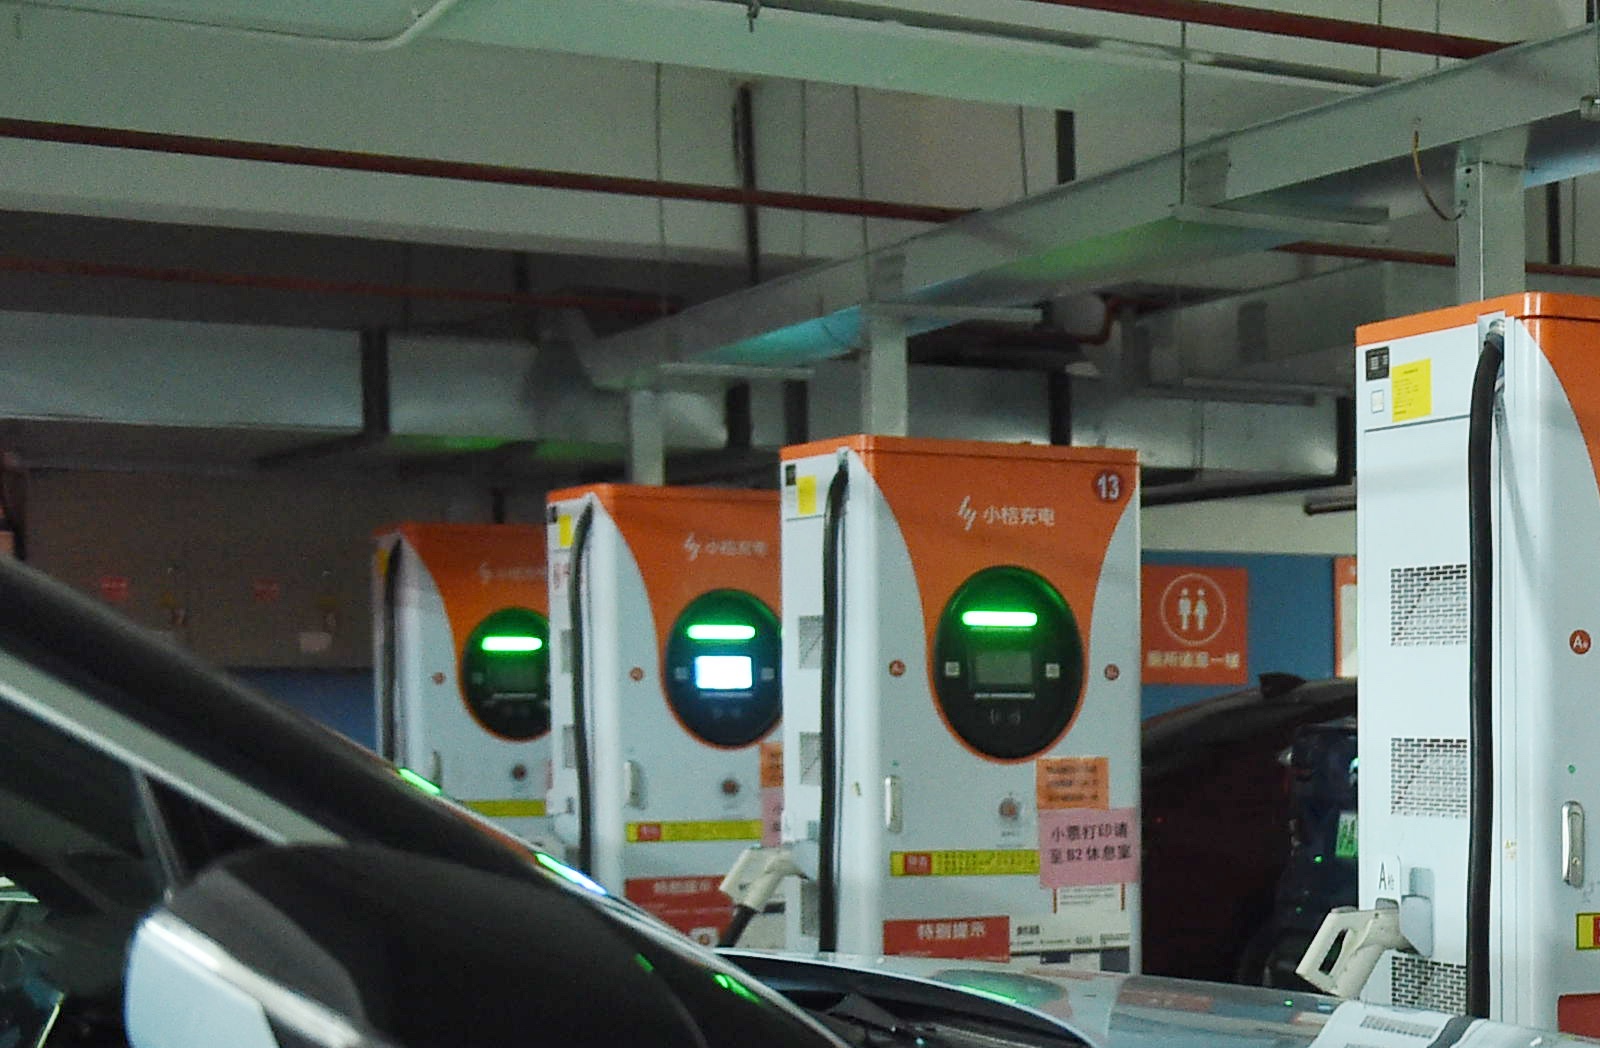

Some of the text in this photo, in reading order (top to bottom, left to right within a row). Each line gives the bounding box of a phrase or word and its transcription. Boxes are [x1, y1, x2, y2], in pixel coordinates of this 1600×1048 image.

[1098, 474, 1120, 501] 13
[983, 505, 1056, 527] 小桔充电
[1051, 822, 1128, 843] 小票打印请
